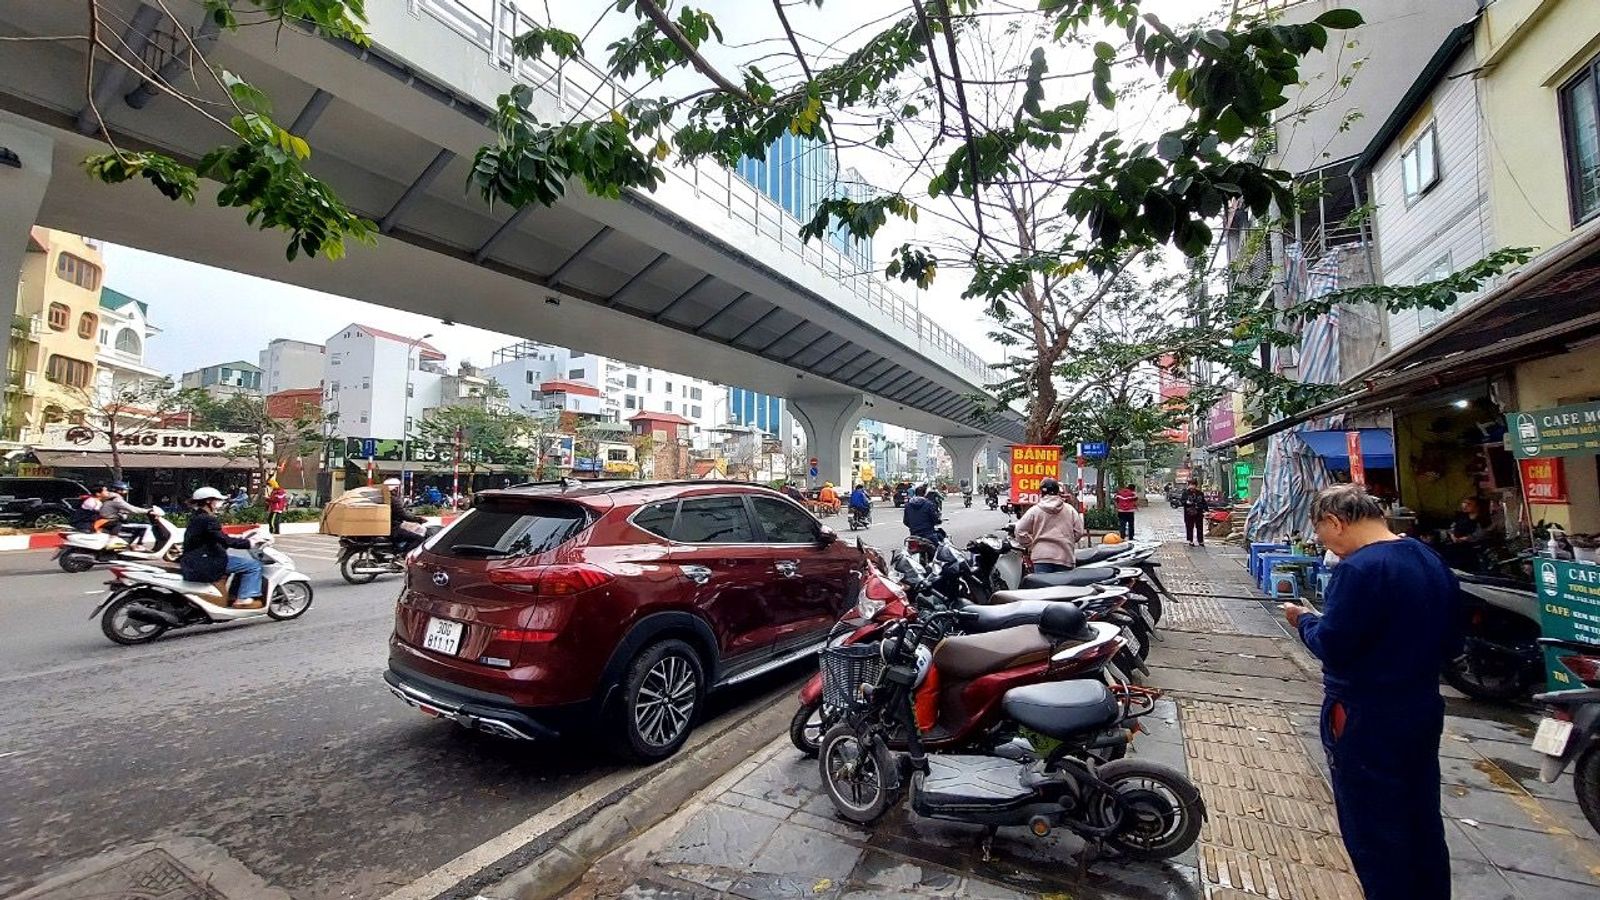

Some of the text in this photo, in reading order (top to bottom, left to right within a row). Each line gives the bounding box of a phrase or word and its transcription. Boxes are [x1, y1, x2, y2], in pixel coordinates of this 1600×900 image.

[1543, 412, 1580, 428] CAFE
[162, 434, 226, 448] HƯNG
[1013, 447, 1058, 461] BÁNH
[1013, 462, 1057, 476] CUỐN
[1018, 479, 1040, 490] CH
[1528, 482, 1553, 497] 20K
[1018, 493, 1039, 504] 20
[1545, 603, 1570, 617] CAFE
